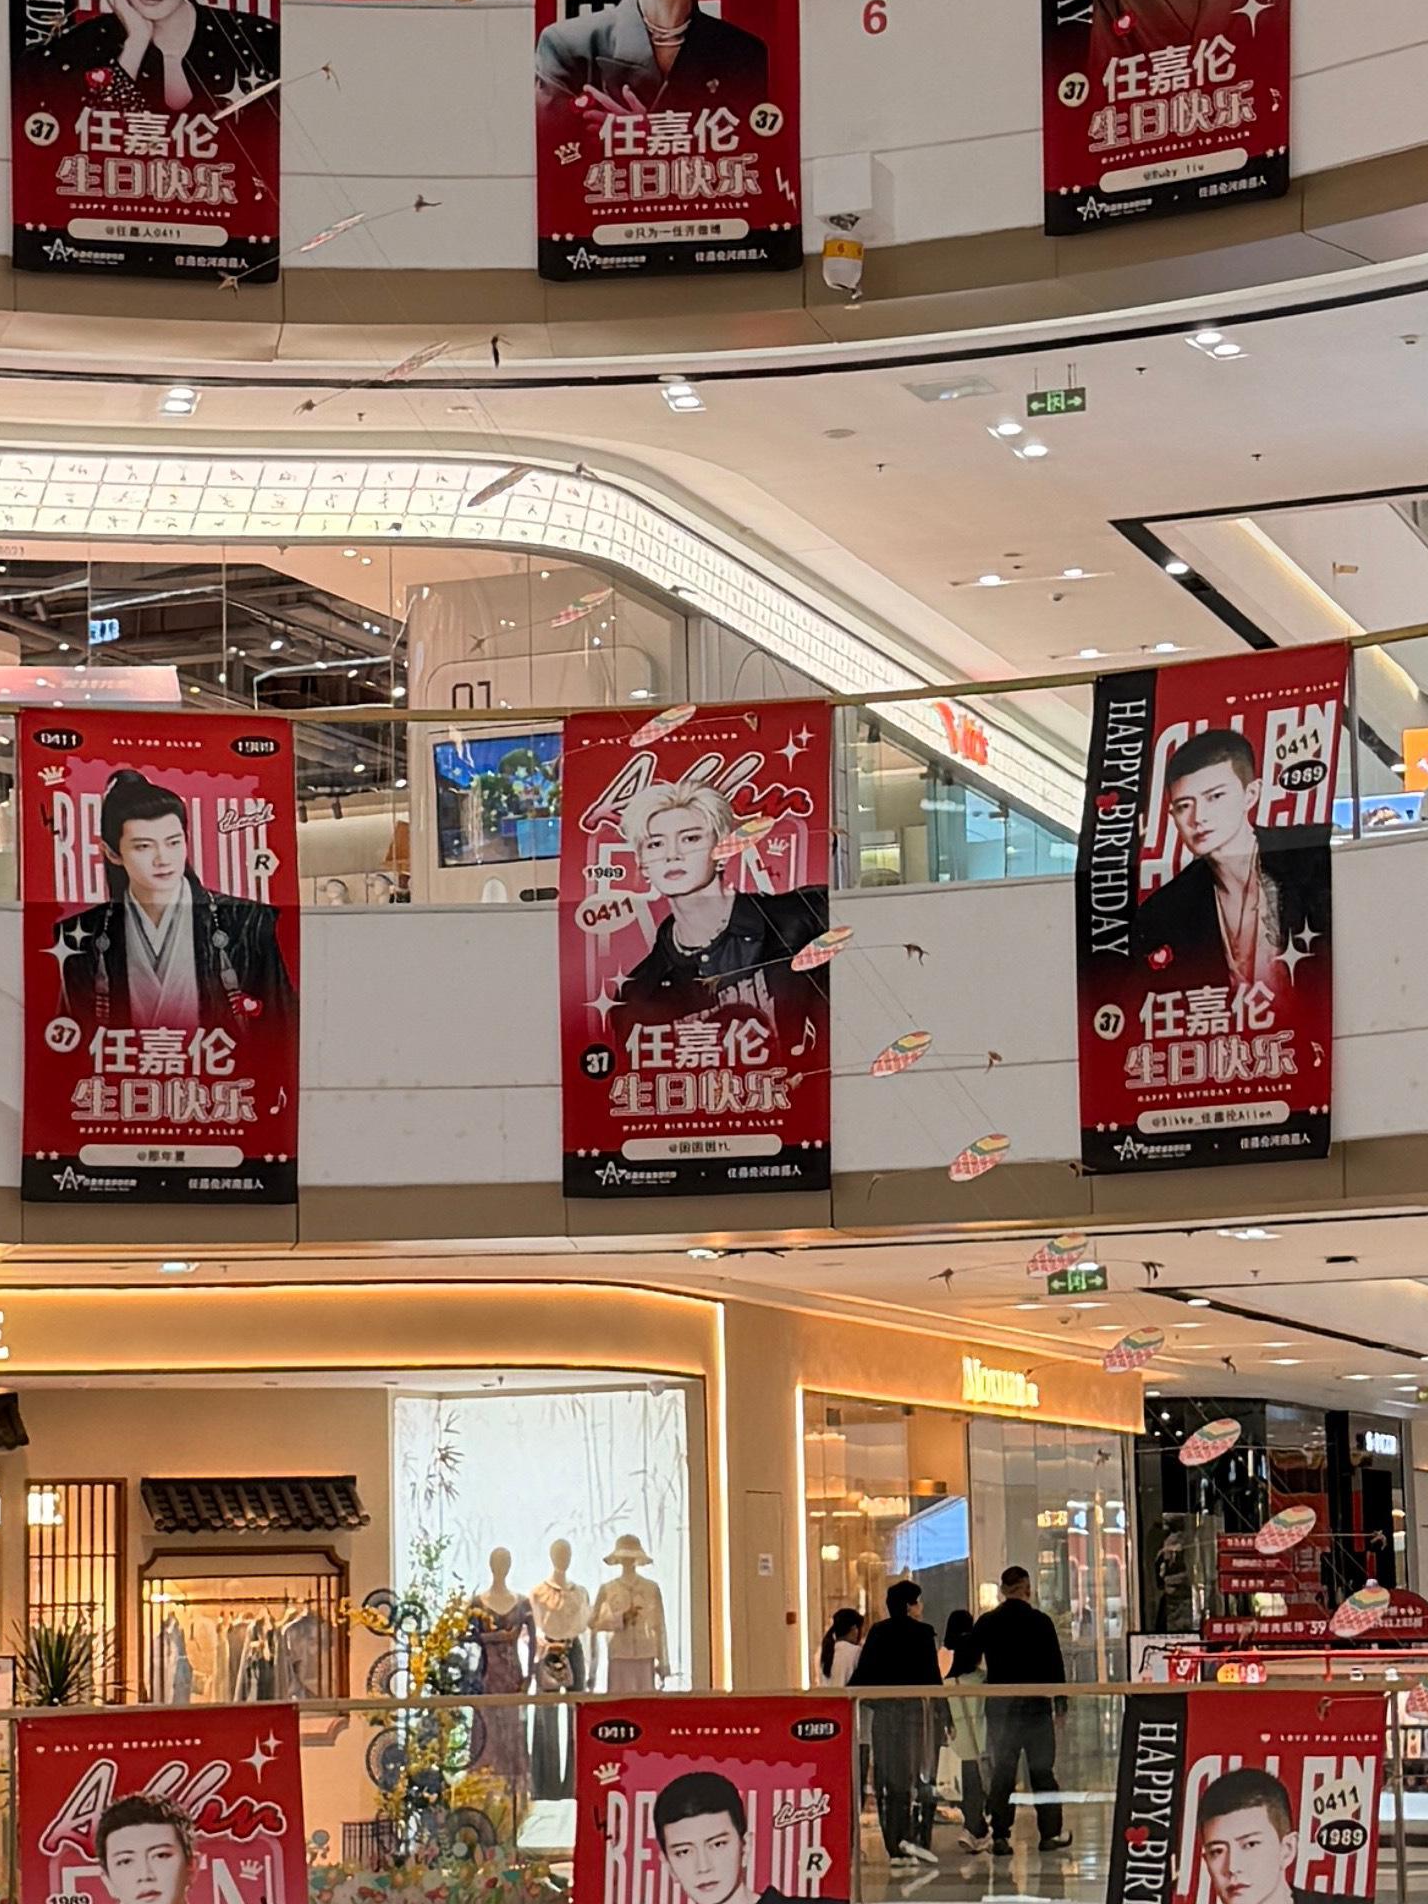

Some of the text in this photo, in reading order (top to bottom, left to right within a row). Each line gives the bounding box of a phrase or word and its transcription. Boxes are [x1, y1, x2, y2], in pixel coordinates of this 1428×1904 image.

[863, 0, 887, 35] 6
[1102, 33, 1236, 103] 任嘉伦
[30, 119, 55, 140] 37
[75, 108, 219, 159] 任嘉伦
[599, 106, 740, 157] 任嘉伦
[755, 109, 780, 129] 37
[1088, 79, 1257, 153] 生日快乐
[55, 156, 238, 205] 生日快乐
[585, 153, 762, 204] 生日快乐
[1276, 728, 1321, 760] 0411
[1280, 764, 1324, 786] 1989
[1090, 698, 1146, 956] HAPPY BIRTHDAY
[1098, 1012, 1122, 1032] 37
[1139, 981, 1274, 1035] 任嘉伦
[50, 1025, 77, 1046] 37
[89, 1027, 237, 1075] 任嘉伦
[626, 1018, 770, 1070] 任嘉伦
[1125, 1030, 1298, 1088] 生日快乐
[72, 1078, 257, 1123] 生日快乐
[610, 1066, 790, 1115] 生日快乐
[1131, 1720, 1177, 1834] HAPPY
[1313, 1786, 1360, 1814] 0411
[1320, 1826, 1363, 1846] 1989
